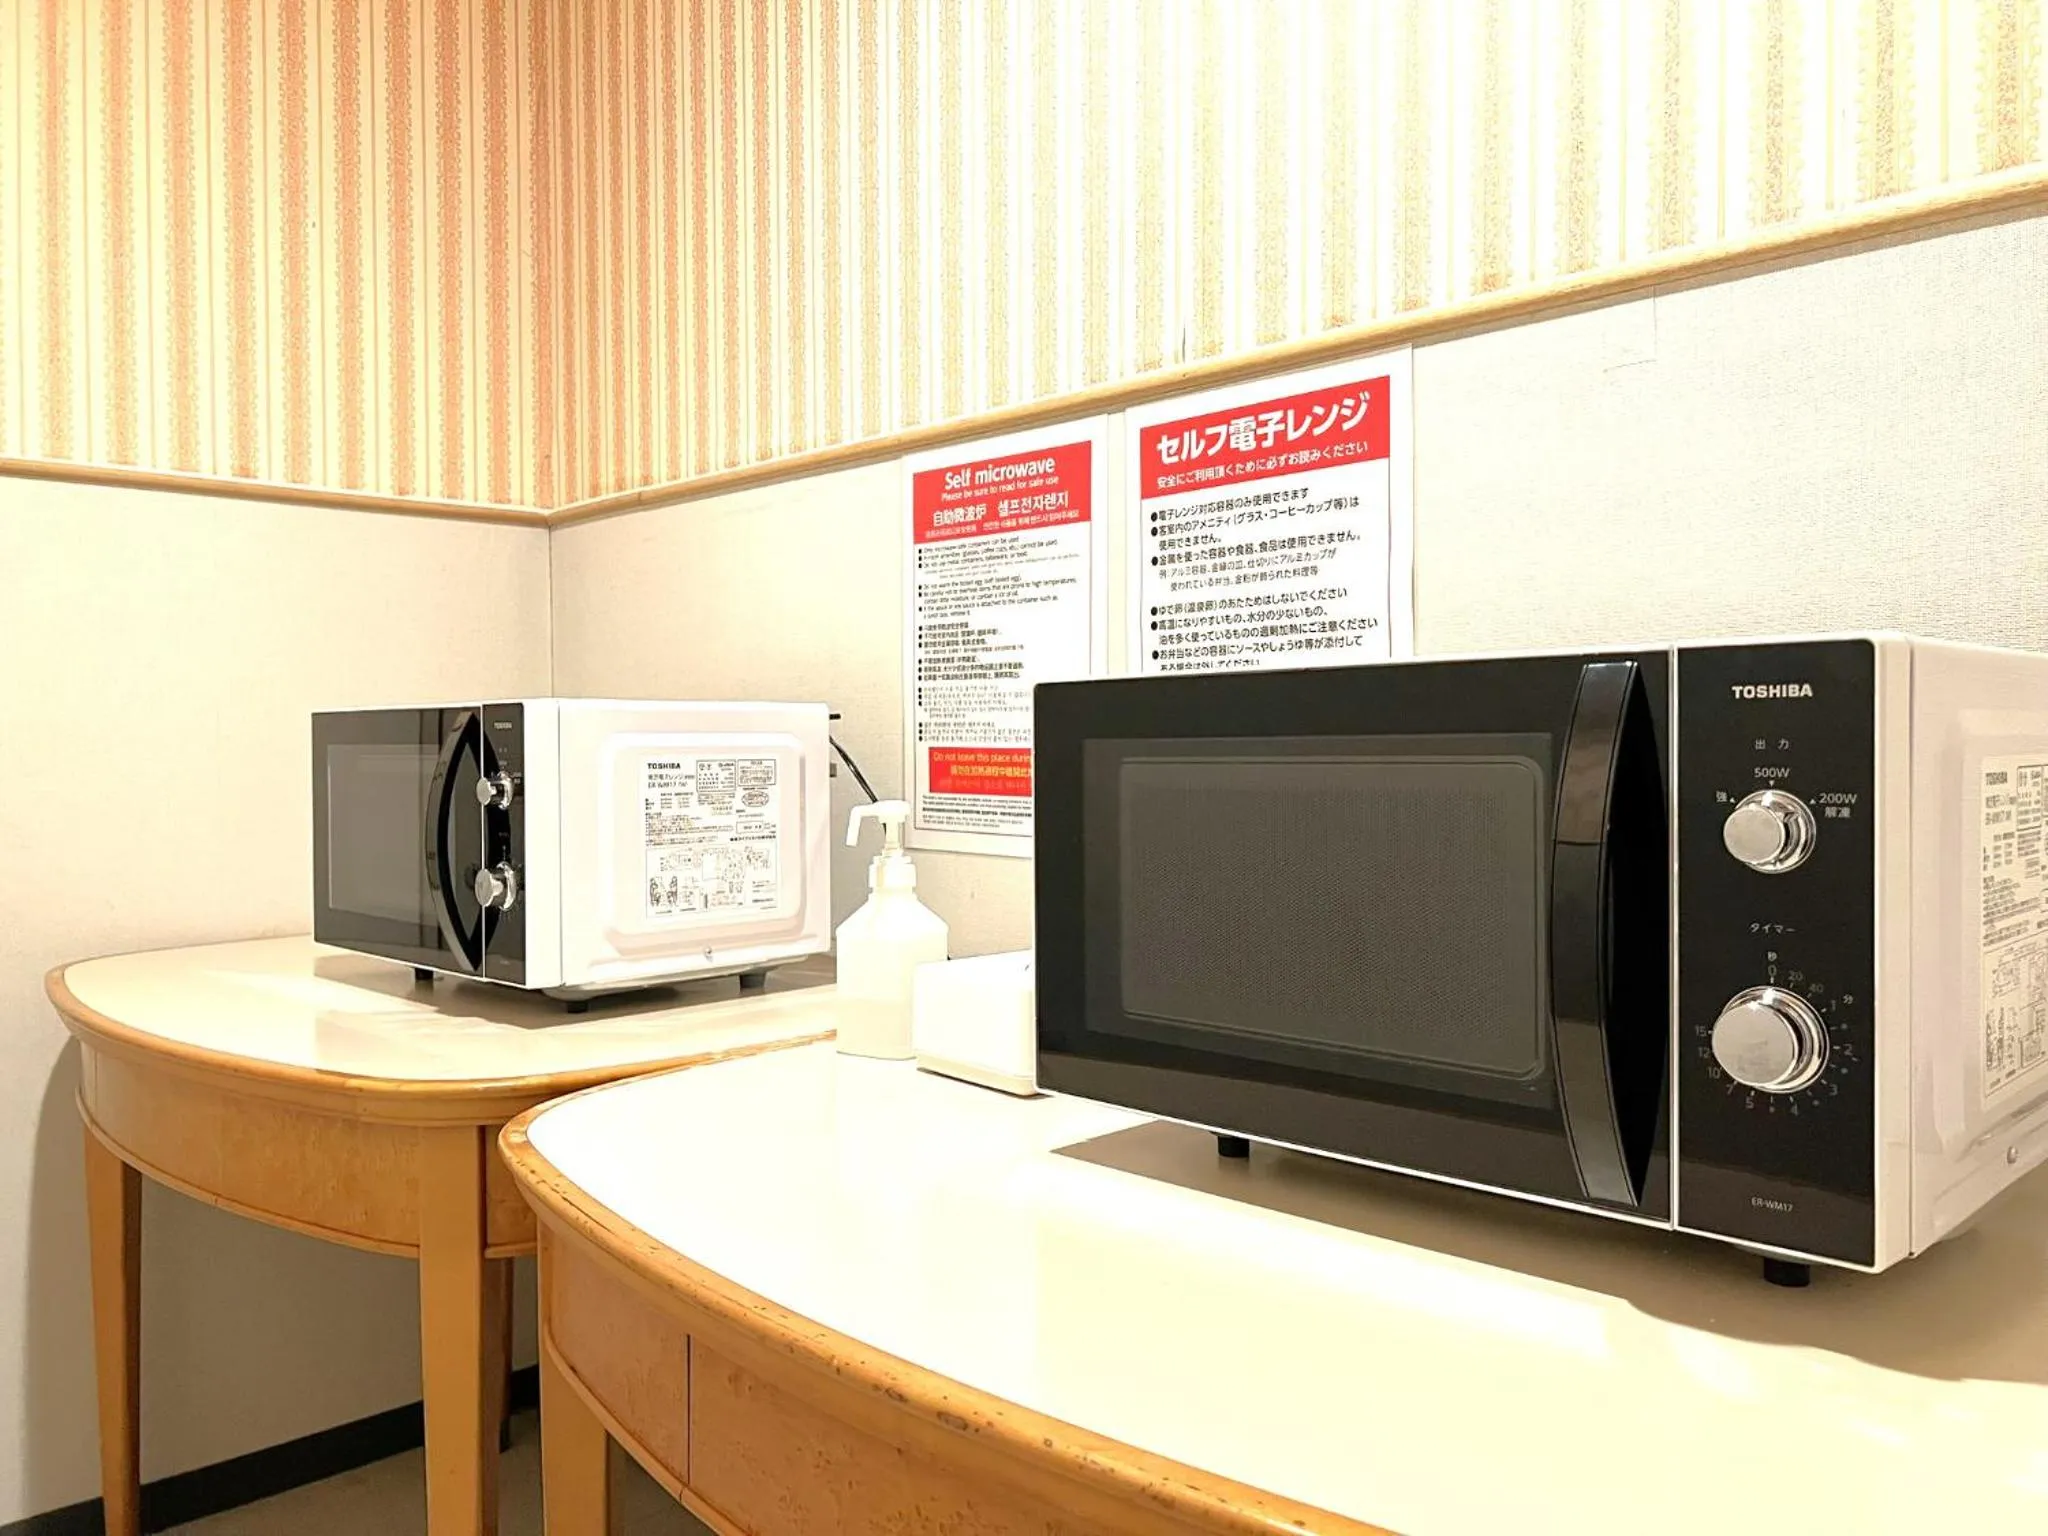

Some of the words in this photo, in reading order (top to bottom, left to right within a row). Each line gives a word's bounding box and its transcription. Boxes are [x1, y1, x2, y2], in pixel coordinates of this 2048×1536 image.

[1156, 390, 1370, 465] セルフ電子レンジ
[945, 468, 971, 489] Self
[975, 457, 1055, 484] microwave
[1157, 441, 1368, 489] 安全にご利用頂くために必ずお読みください
[1159, 488, 1309, 521] 電子レンジ対応容器のみ使用できます
[1159, 533, 1222, 551] 使用できません。
[1731, 683, 1814, 700] TOSHIBA
[647, 762, 681, 770] TOSHIBA
[1754, 767, 1790, 778] 500W
[1819, 792, 1857, 805] 200W
[1750, 922, 1796, 934] タイマー
[1768, 964, 1777, 977] 0
[1752, 1197, 1793, 1212] ER-WM17
